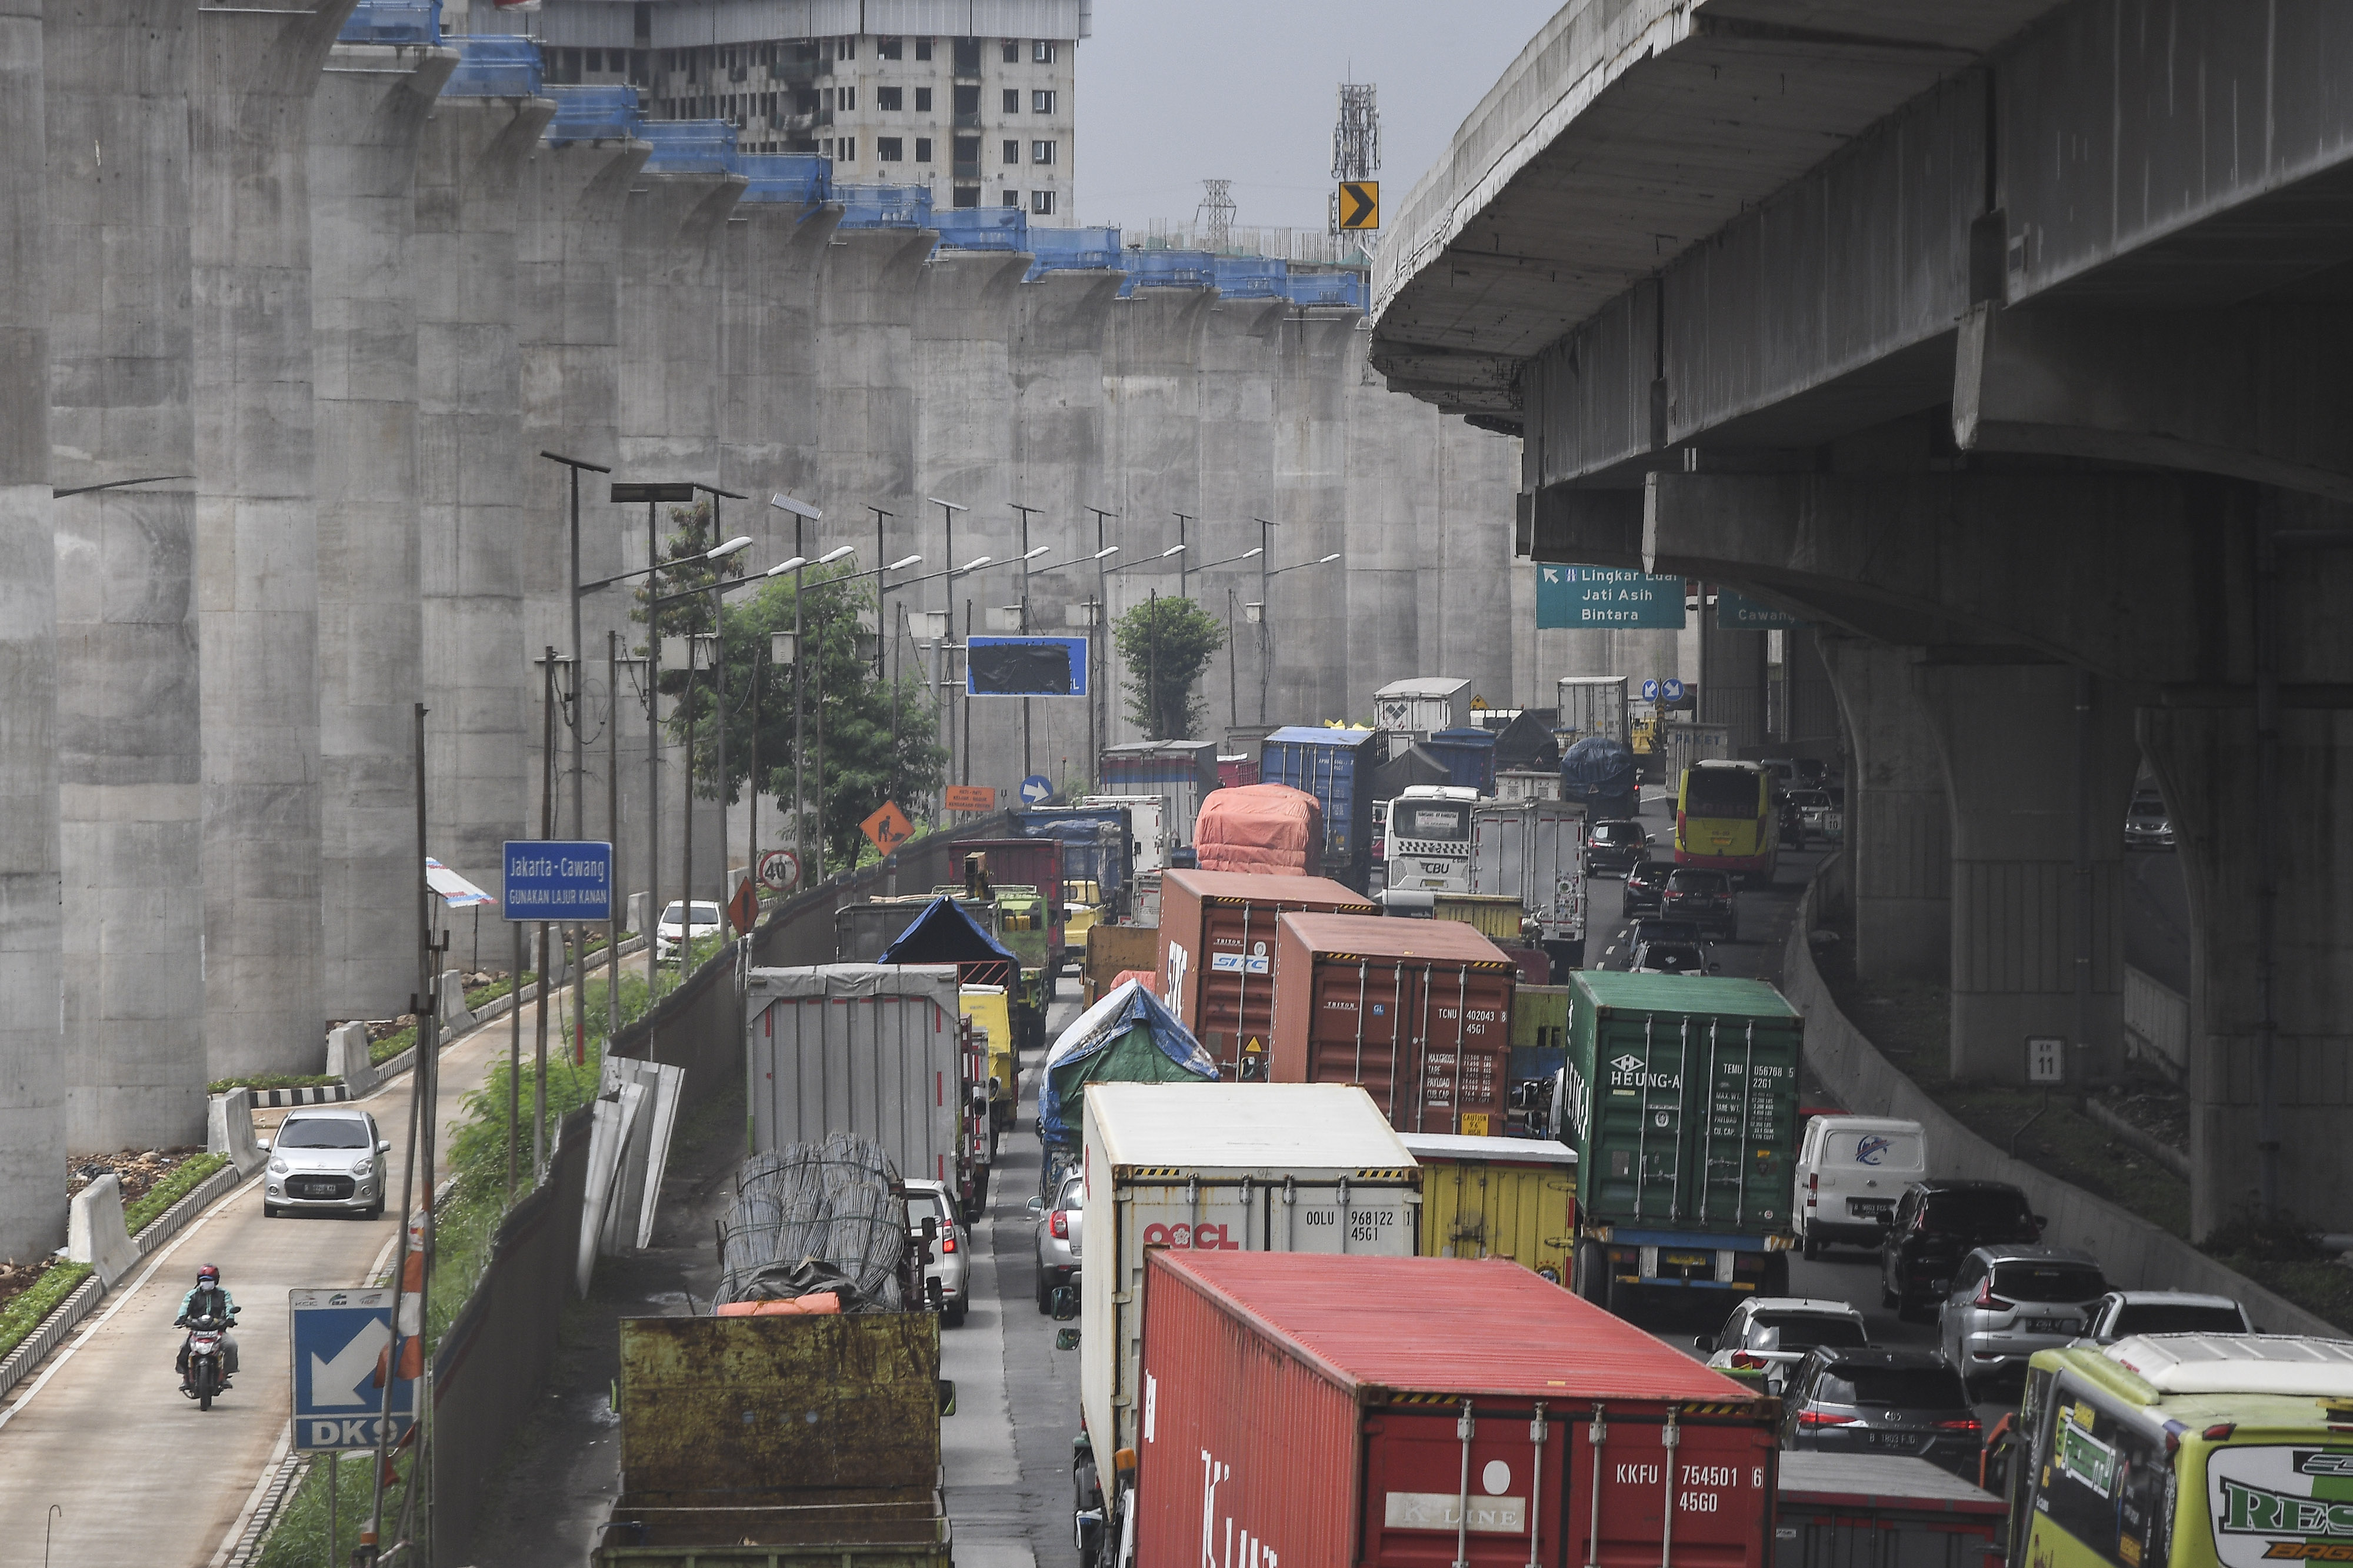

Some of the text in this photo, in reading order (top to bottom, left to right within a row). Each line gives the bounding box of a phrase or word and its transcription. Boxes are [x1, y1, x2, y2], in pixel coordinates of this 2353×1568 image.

[1581, 569, 1639, 584] Lingkar
[1582, 589, 1652, 600] Jati Asih
[1581, 608, 1638, 620] Bintara
[765, 861, 786, 880] 40
[1425, 863, 1449, 874] CBU
[509, 889, 606, 904] GUNAKAN LAJUR KANAN
[1214, 958, 1268, 969] SITC
[1439, 1008, 1507, 1022] TCNU 402043 8
[1467, 1023, 1485, 1035] 45G1
[1723, 1063, 1795, 1078] TEMU 056768 5
[2039, 1057, 2052, 1074] 11
[1427, 1077, 1450, 1088] PAYLOAD
[1611, 1071, 1681, 1089] HEUNG-A
[1753, 1077, 1772, 1089] 22G1
[1351, 1211, 1393, 1226] 968122
[1351, 1226, 1379, 1242] 45G1
[1616, 1464, 1762, 1487] KKFU 754501 6
